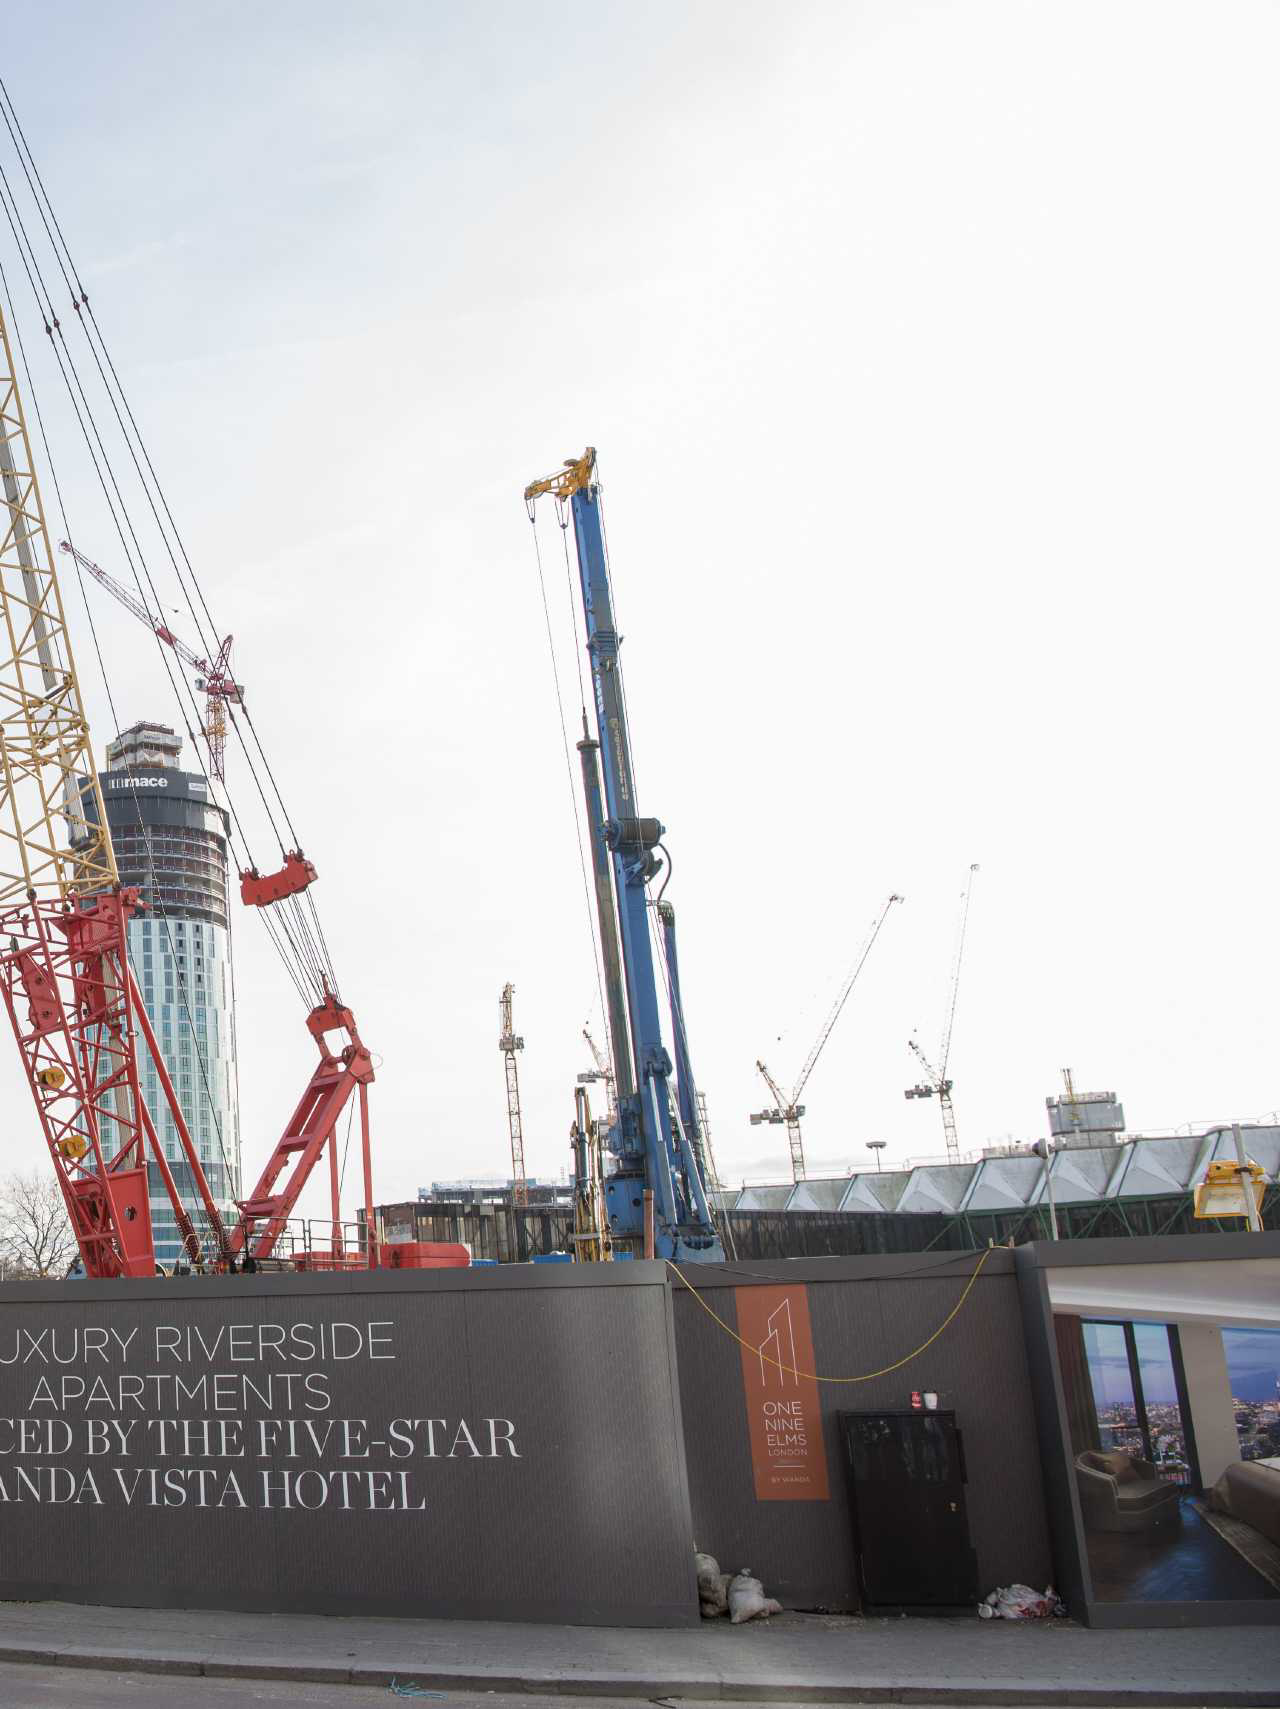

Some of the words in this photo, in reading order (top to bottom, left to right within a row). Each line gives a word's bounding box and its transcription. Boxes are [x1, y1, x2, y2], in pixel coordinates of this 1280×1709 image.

[156, 1321, 396, 1362] RIVERSIDE
[28, 1373, 332, 1411] APARTMENTS
[763, 1401, 802, 1416] ONE
[765, 1418, 805, 1431] NINE
[87, 1419, 137, 1456] BY
[148, 1418, 245, 1457] THE
[257, 1418, 523, 1459] FIVE-STAR
[767, 1434, 808, 1446] ELMS
[768, 1448, 808, 1457] LONDON
[113, 1468, 249, 1507] VISTA
[259, 1469, 427, 1510] HOTEL
